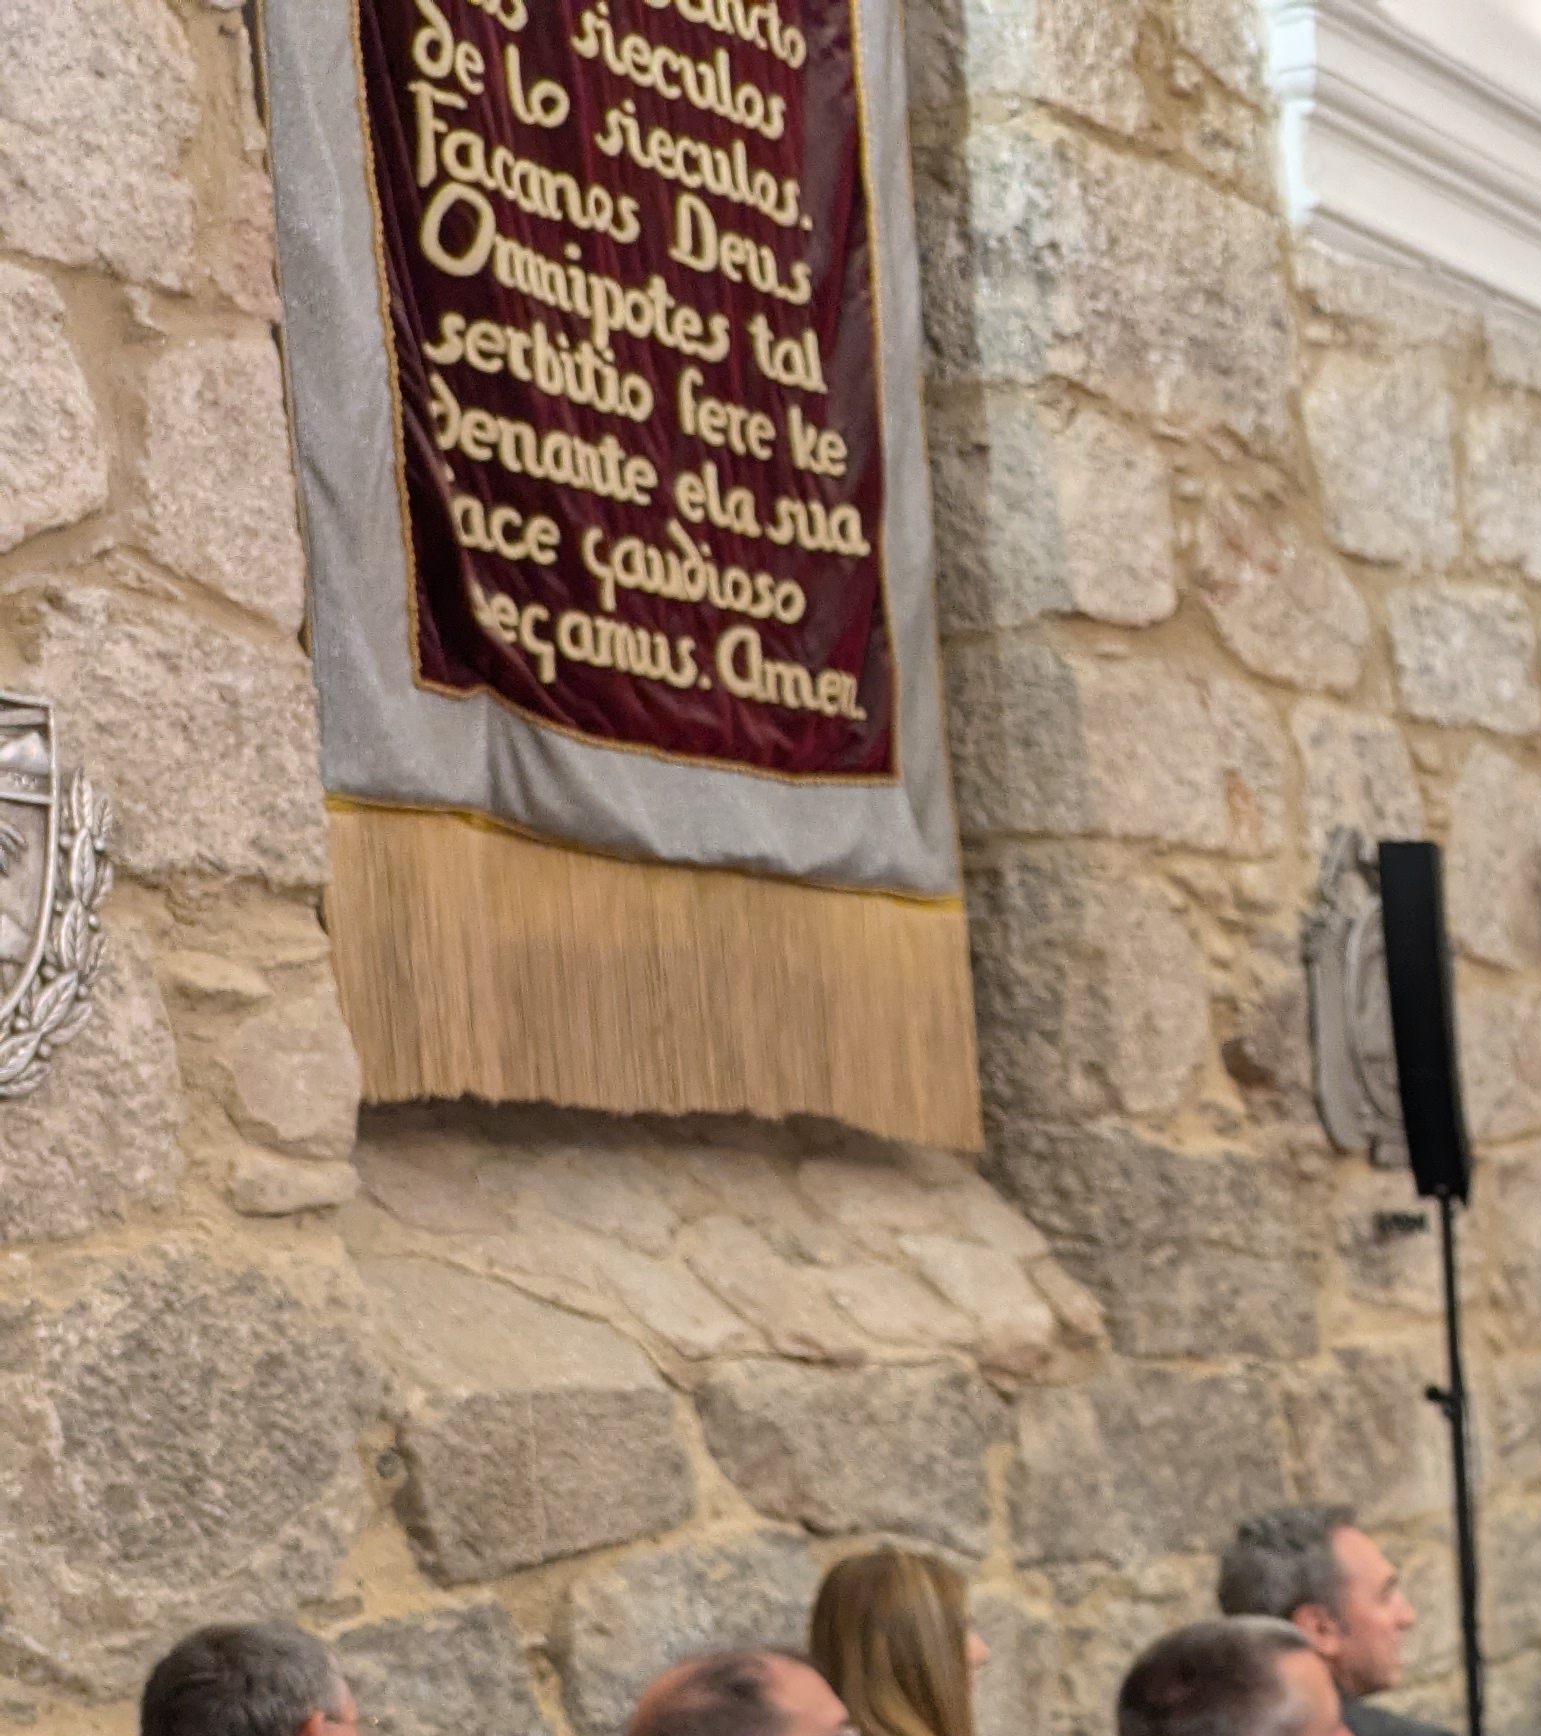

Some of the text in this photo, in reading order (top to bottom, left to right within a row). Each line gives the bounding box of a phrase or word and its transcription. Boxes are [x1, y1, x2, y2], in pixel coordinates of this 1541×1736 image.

[413, 0, 485, 94] de
[506, 44, 570, 128] lo
[571, 1, 785, 139] sieculos
[408, 81, 811, 305] Facanos Deus
[421, 182, 827, 394] Omnipotes tal
[789, 405, 847, 476] ke
[675, 462, 761, 537] ela
[766, 498, 870, 557] sua
